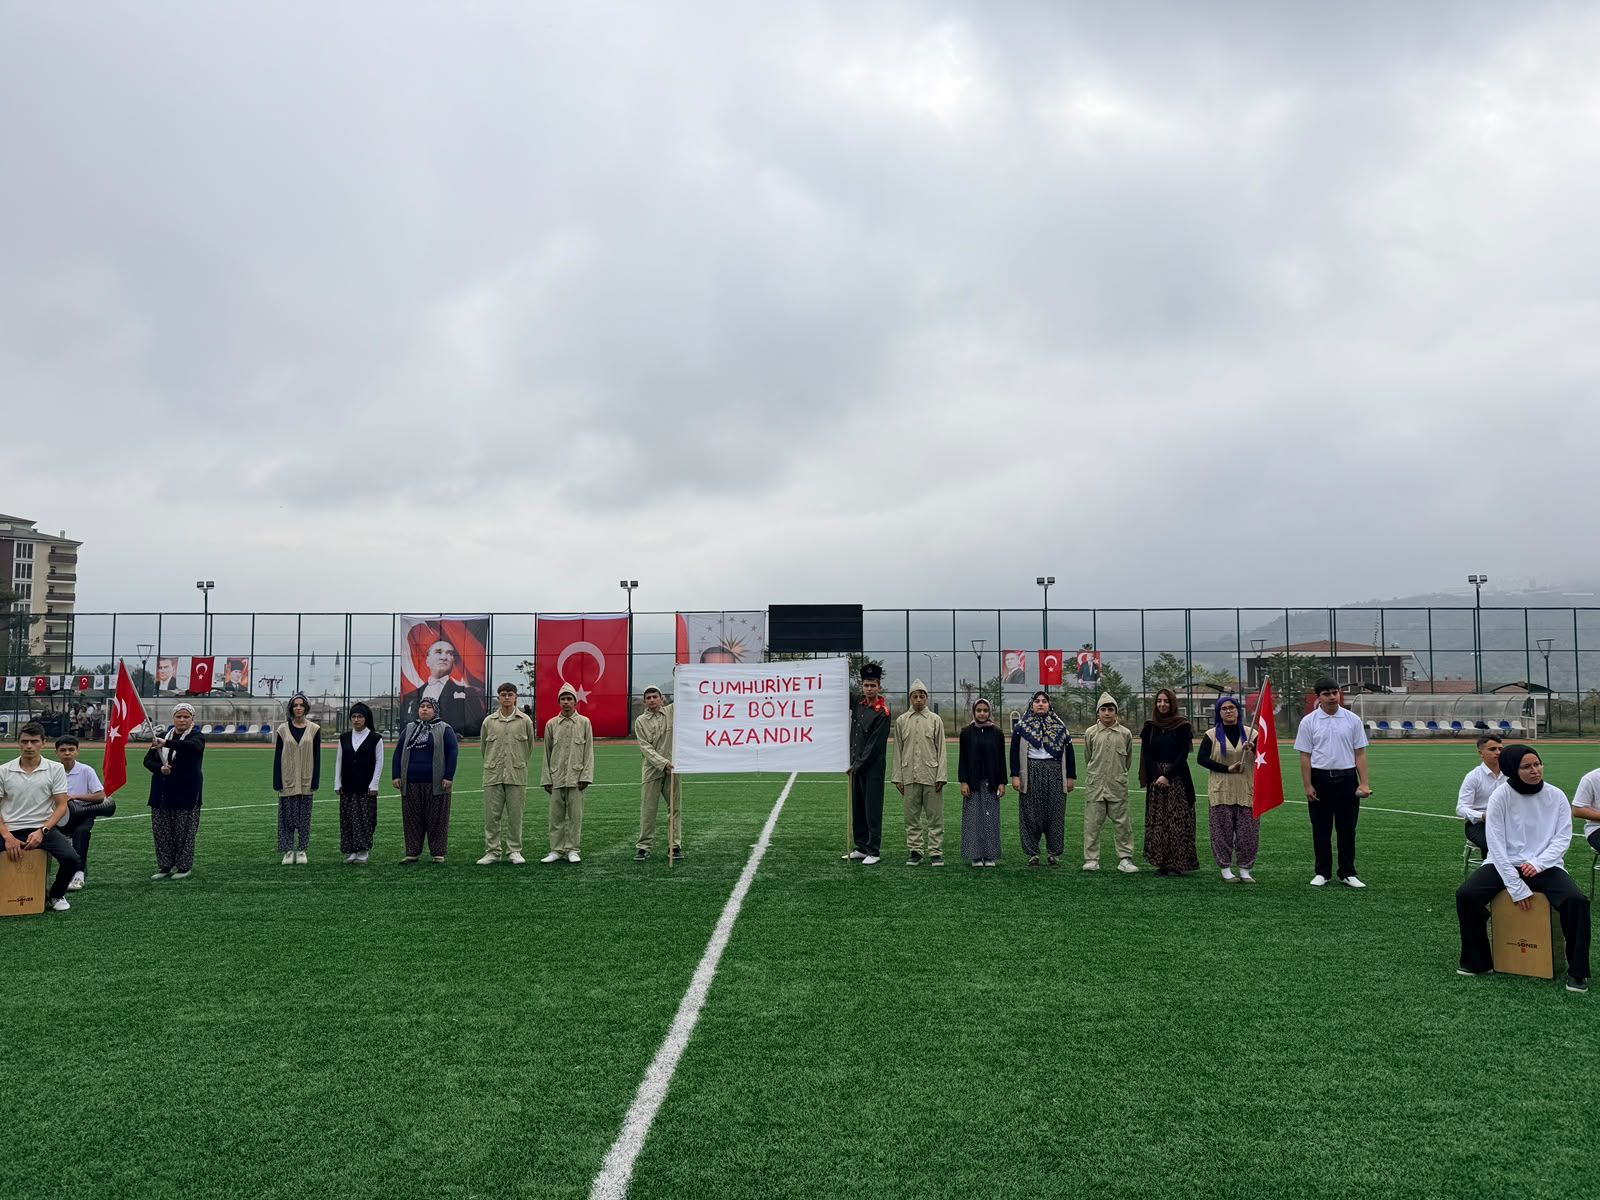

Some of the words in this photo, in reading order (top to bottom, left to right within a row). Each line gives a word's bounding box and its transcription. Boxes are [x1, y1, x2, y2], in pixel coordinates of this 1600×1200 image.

[699, 674, 822, 695] CUMHURİYETİ
[703, 700, 735, 720] BİZ
[748, 697, 814, 718] BÖYLE
[705, 727, 813, 747] KAZANDIK
